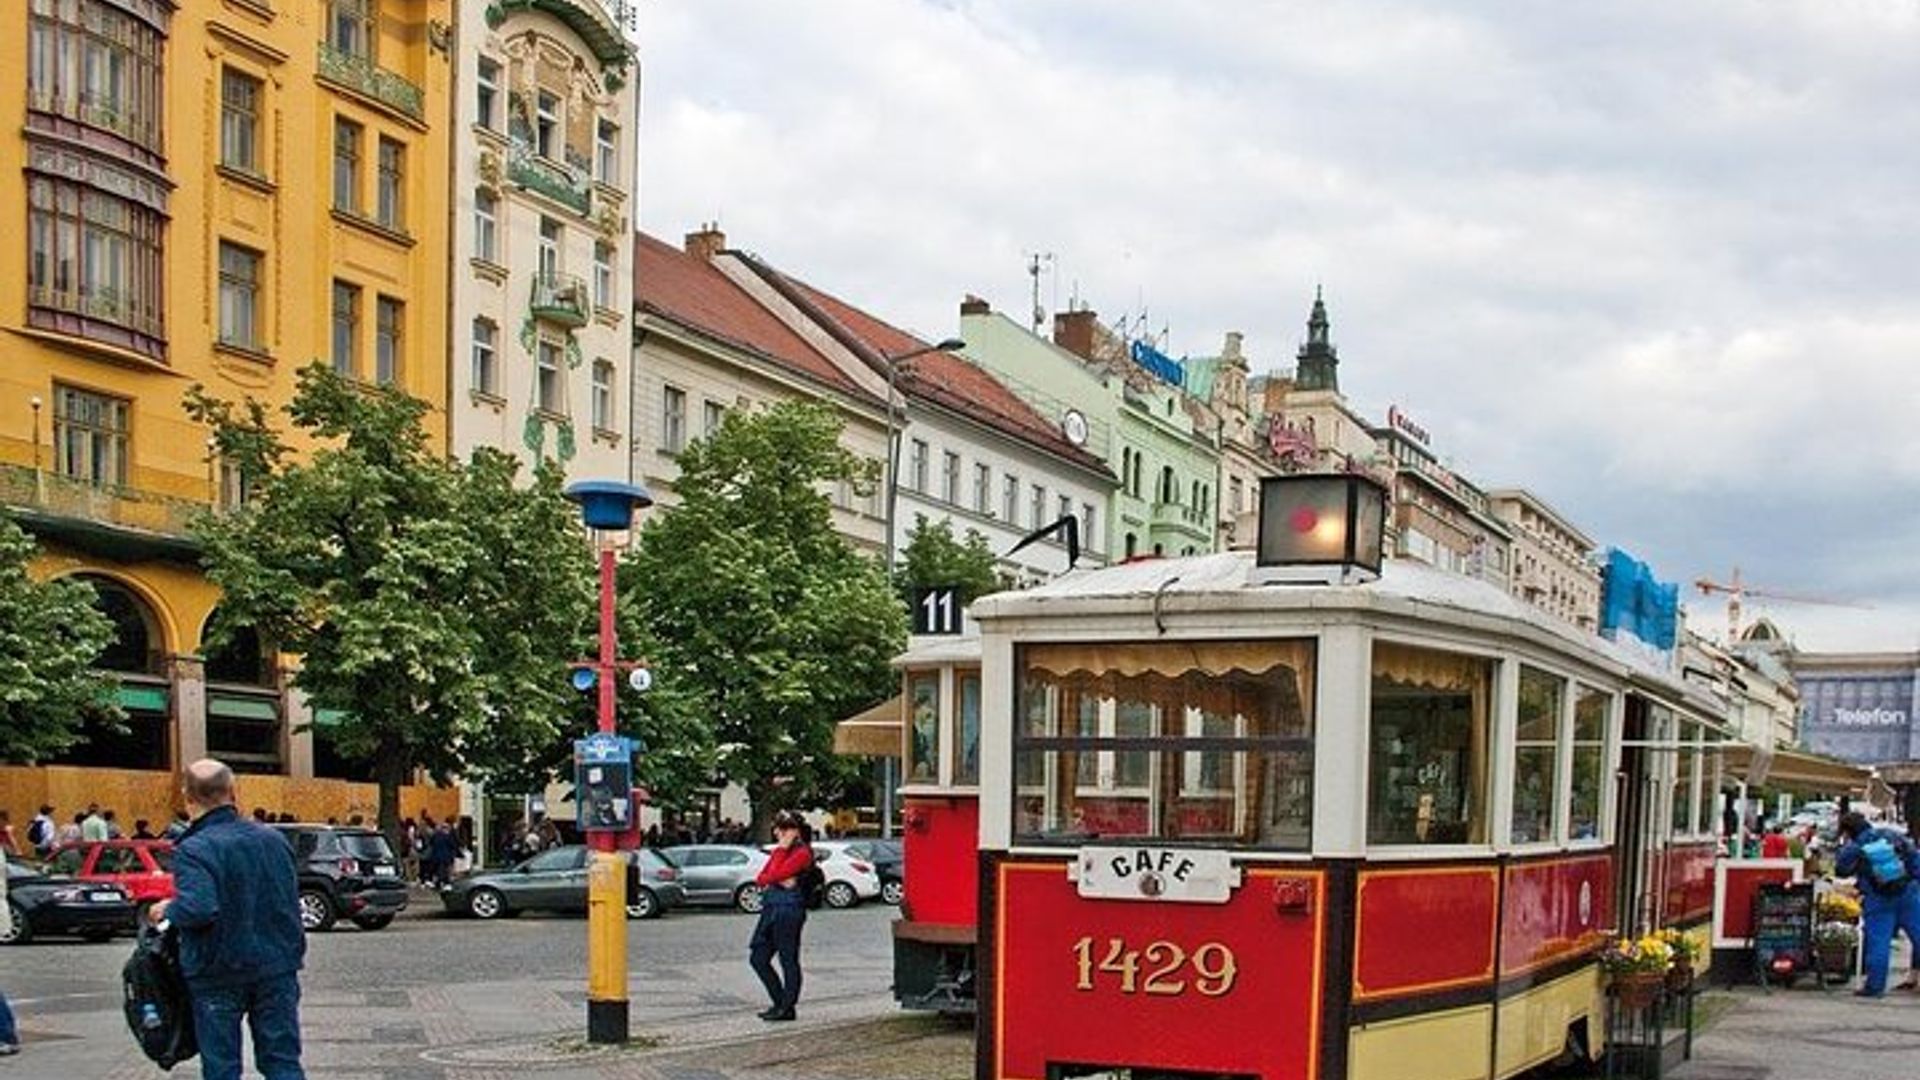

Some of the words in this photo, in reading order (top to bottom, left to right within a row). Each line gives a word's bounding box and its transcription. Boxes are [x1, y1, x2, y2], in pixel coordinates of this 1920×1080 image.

[922, 590, 952, 632] 11
[1834, 707, 1905, 725] Telefon
[1111, 850, 1195, 882] CAFE
[1072, 936, 1238, 996] 1429
